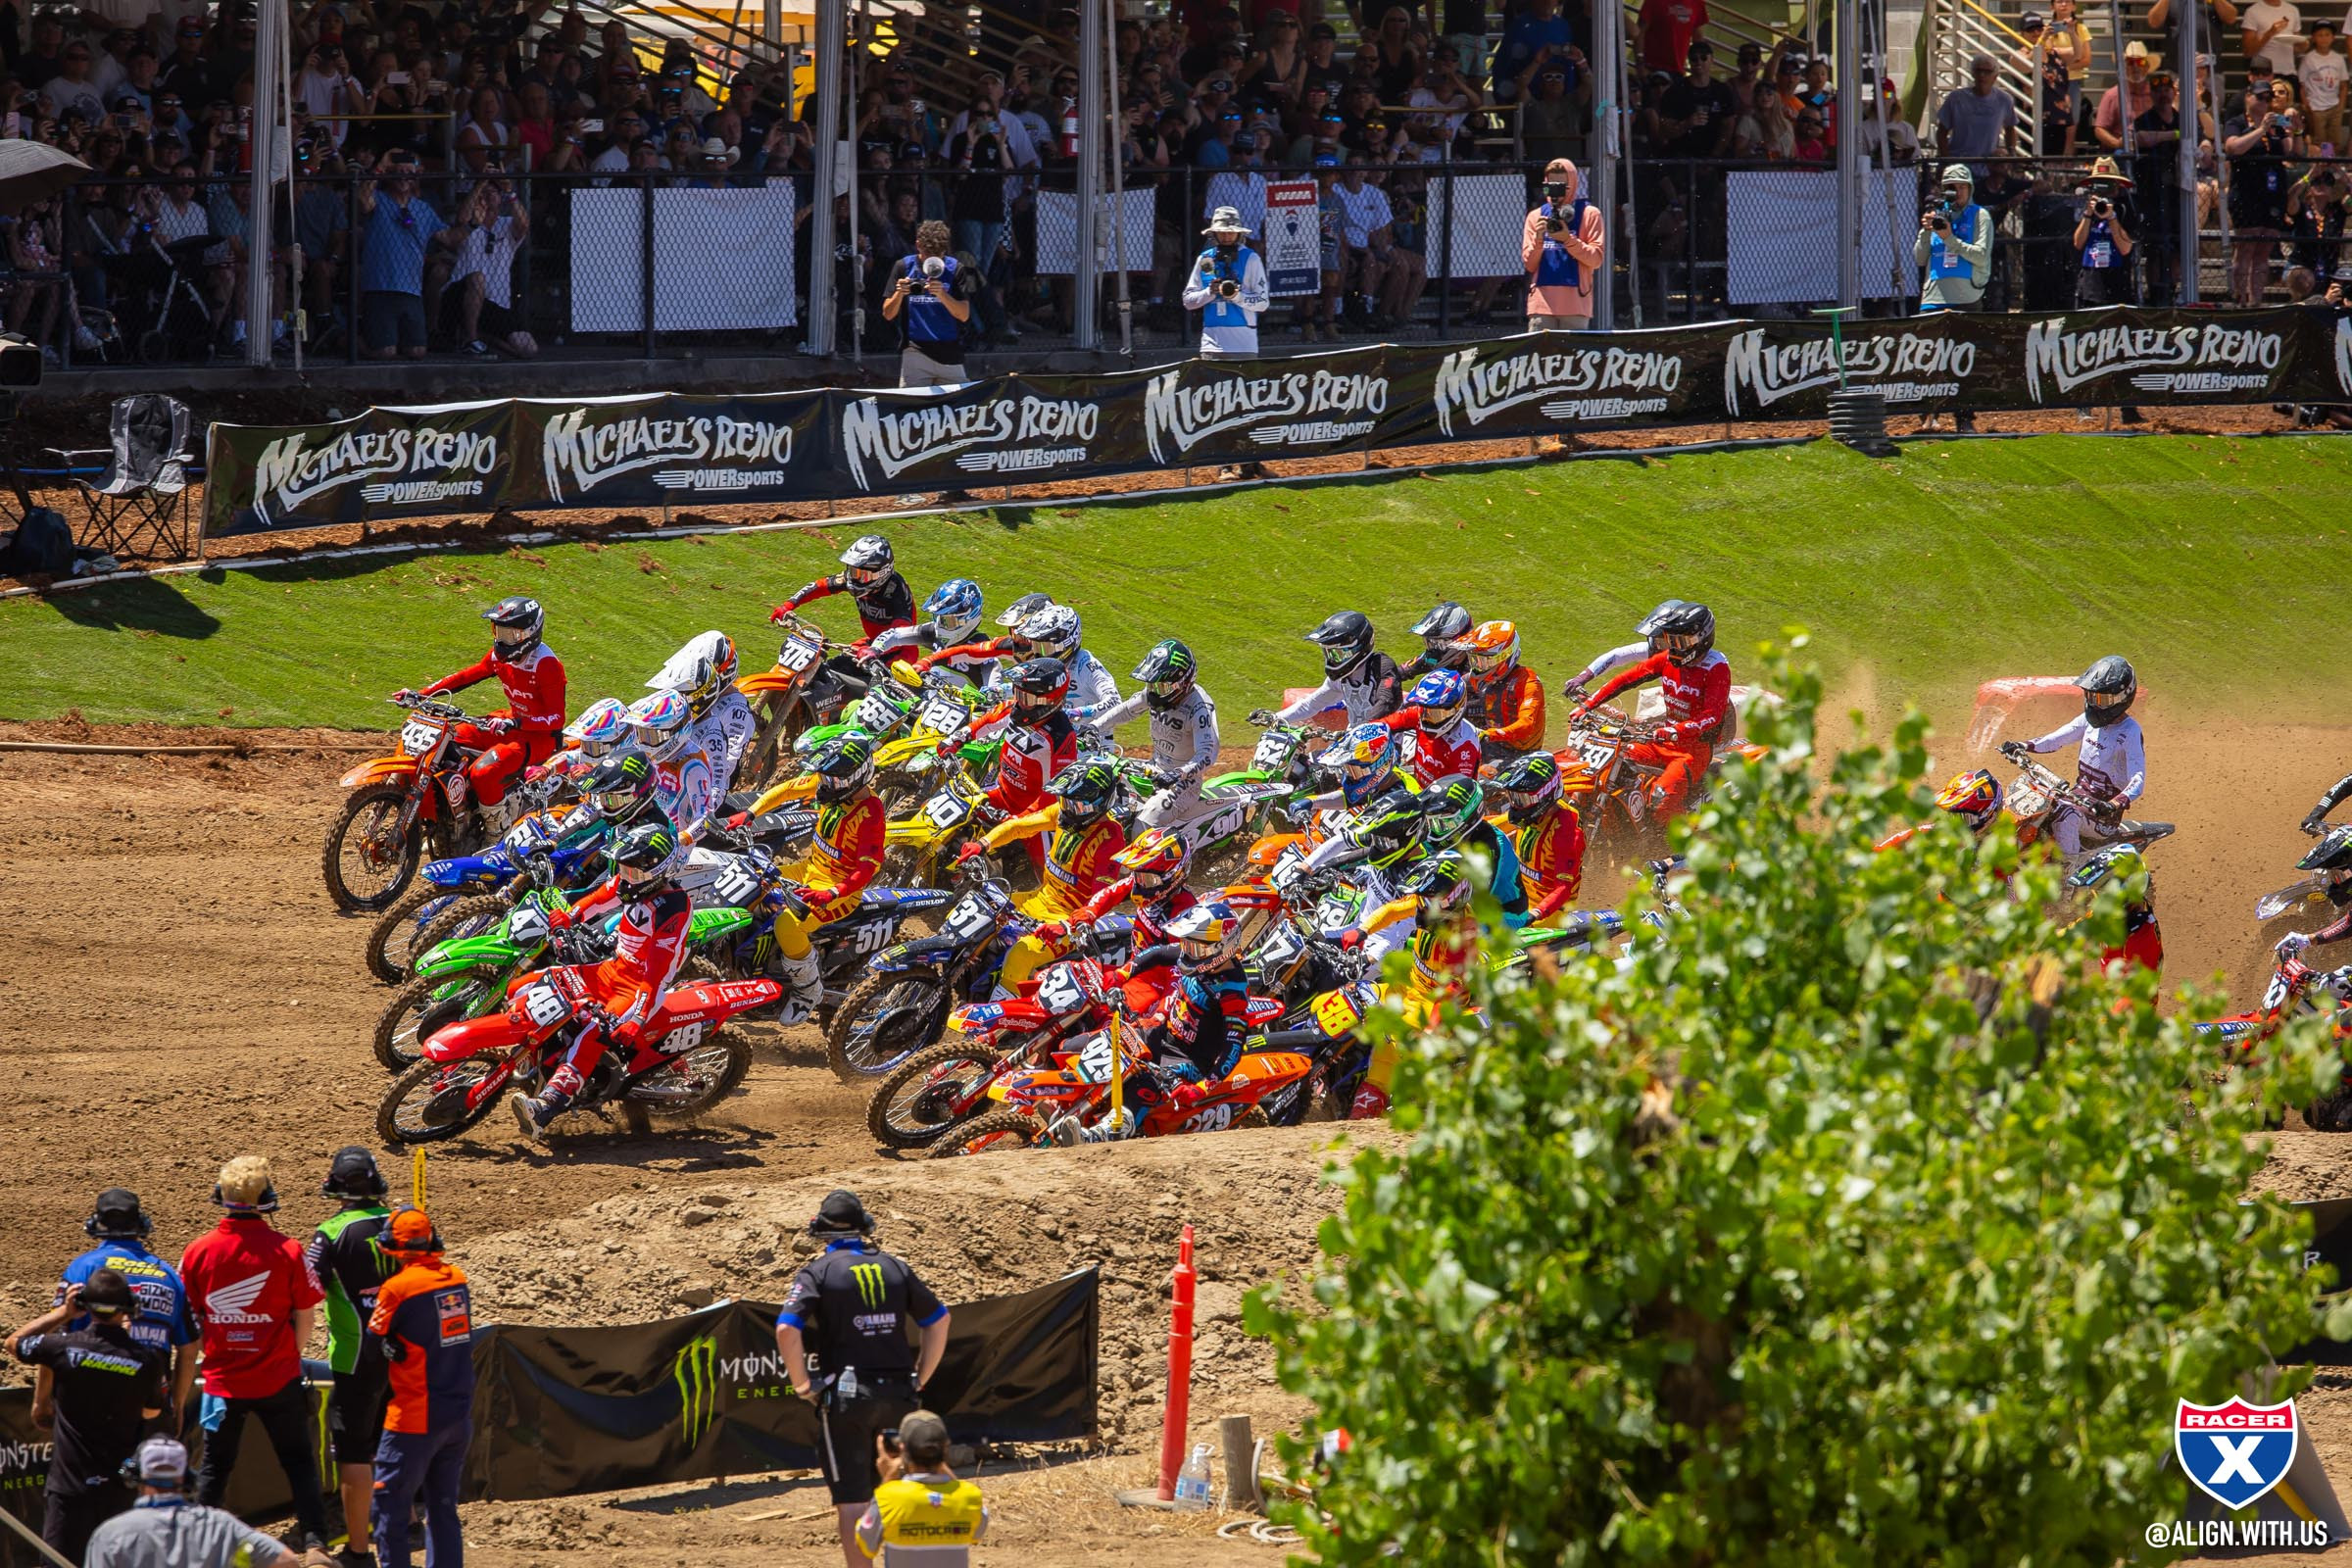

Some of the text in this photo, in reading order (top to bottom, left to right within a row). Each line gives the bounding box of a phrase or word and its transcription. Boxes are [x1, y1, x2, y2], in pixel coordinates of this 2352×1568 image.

[1725, 328, 1976, 417] MICHAEL'S RENO
[2026, 317, 2199, 404] MICHAEL'S
[2195, 324, 2281, 368] RENO
[1434, 347, 1682, 437] MICHAEL'S RENO
[1145, 370, 1389, 465] MICHAEL'S RENO
[543, 407, 793, 504] MICHAEL'S RENO
[843, 396, 1100, 491] MICHAEL'S RENO
[253, 428, 497, 526] MICHAEL'S RENO
[777, 641, 815, 672] 376
[814, 693, 843, 710] WELCH
[857, 694, 899, 731] 565
[921, 699, 966, 735] 128
[401, 721, 443, 752] 435
[1199, 713, 1212, 729] 90
[708, 738, 723, 753] 35
[1580, 743, 1616, 770] 337
[926, 792, 964, 829] 40
[1212, 808, 1244, 841] 90
[842, 806, 872, 853] THOR
[1079, 827, 1111, 877] THOR
[713, 860, 759, 905] 511
[625, 904, 651, 928] LY
[915, 898, 946, 906] DUNLOP
[948, 900, 994, 939] 31
[509, 907, 551, 942] 47
[855, 916, 894, 956] 511
[526, 985, 565, 1027] 48
[730, 996, 765, 1009] DUNLOP
[1038, 965, 1080, 1015] 34
[668, 1011, 706, 1023] HONDA
[1317, 992, 1358, 1039] 38
[659, 1021, 703, 1054] 48
[1081, 1036, 1126, 1084] 929
[475, 1068, 510, 1102] DUNLOP
[207, 1313, 274, 1325] HONDA
[80, 1359, 138, 1377] RACING
[737, 1384, 796, 1399] ENER
[4, 1474, 46, 1490] NERG
